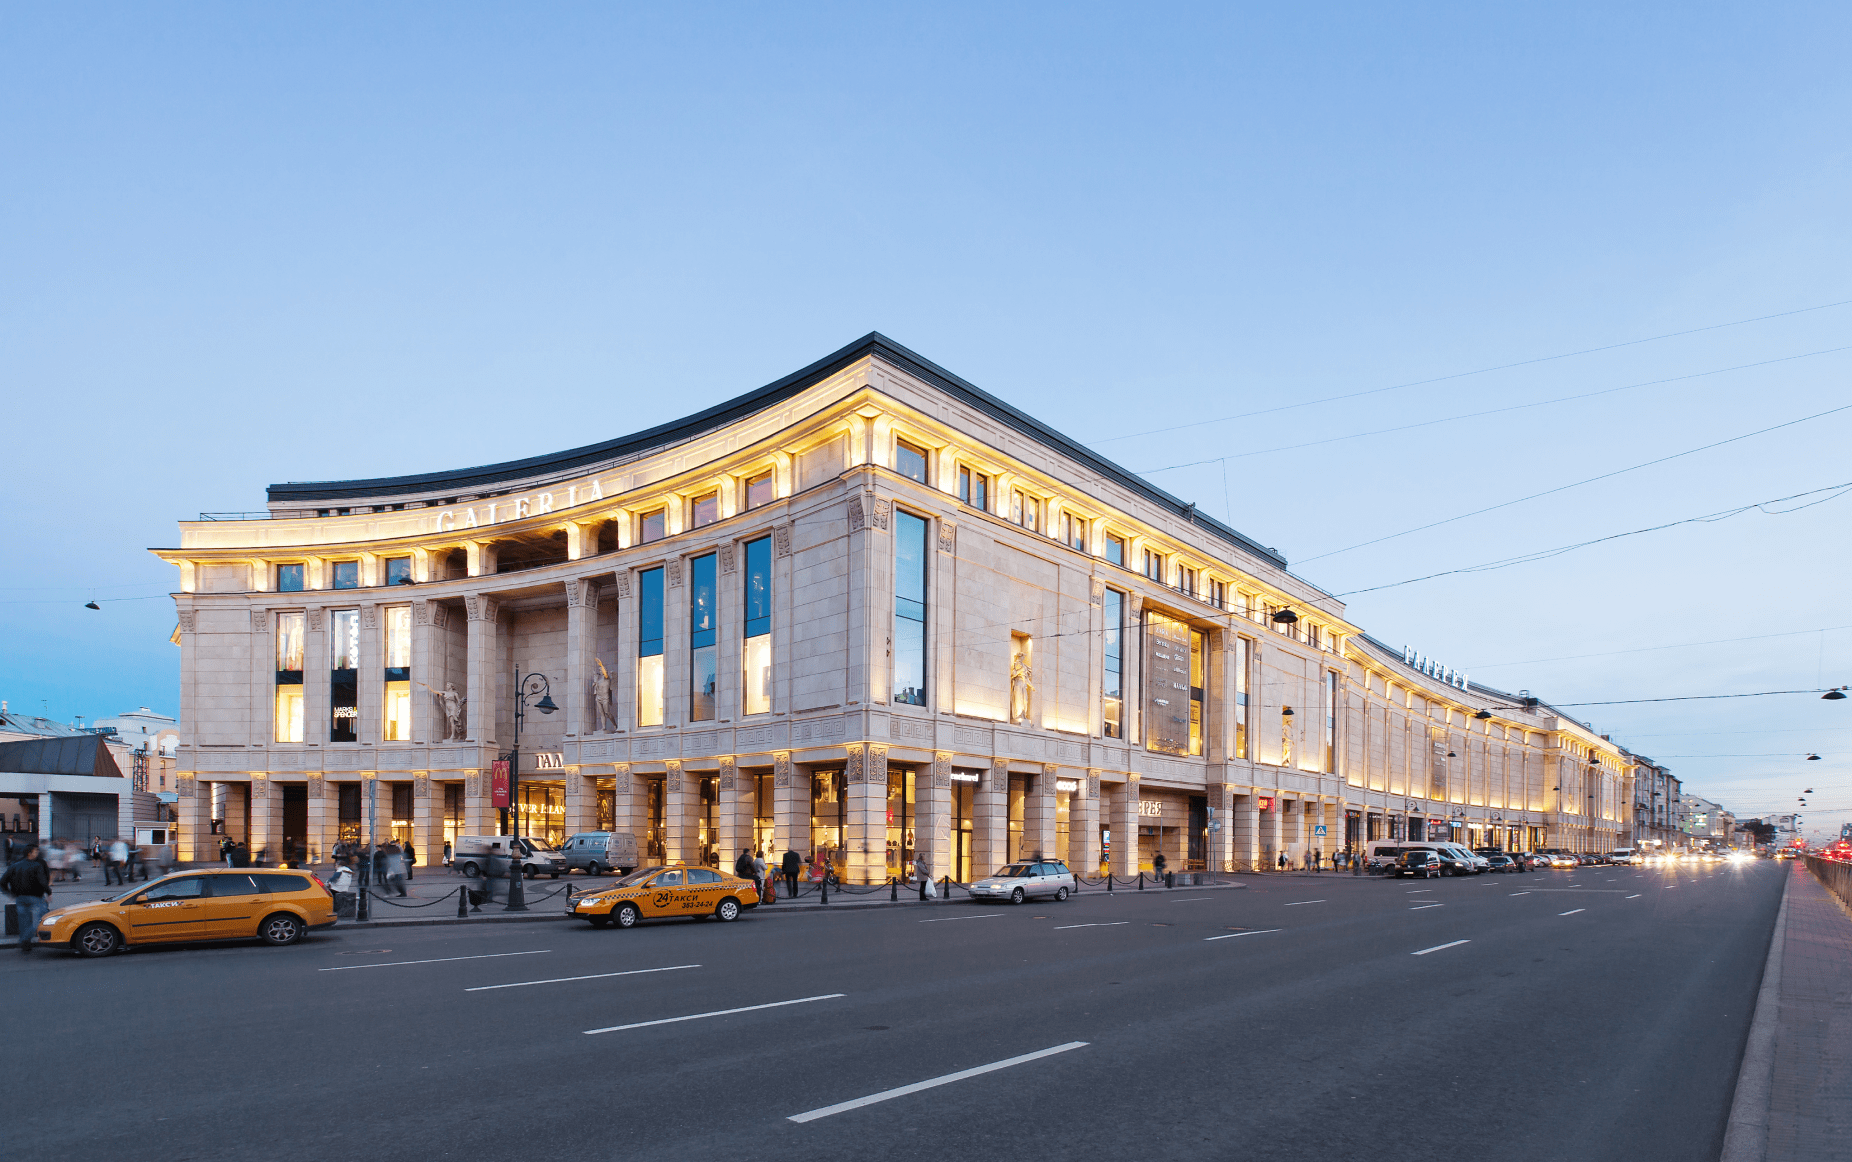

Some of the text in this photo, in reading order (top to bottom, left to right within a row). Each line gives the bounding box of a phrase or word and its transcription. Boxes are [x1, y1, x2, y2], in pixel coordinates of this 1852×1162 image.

[437, 479, 604, 533] GALERIA
[1404, 645, 1469, 692] ГАЛЕРЕЯ
[150, 901, 178, 909] ТАКСИ
[656, 893, 669, 903] 24
